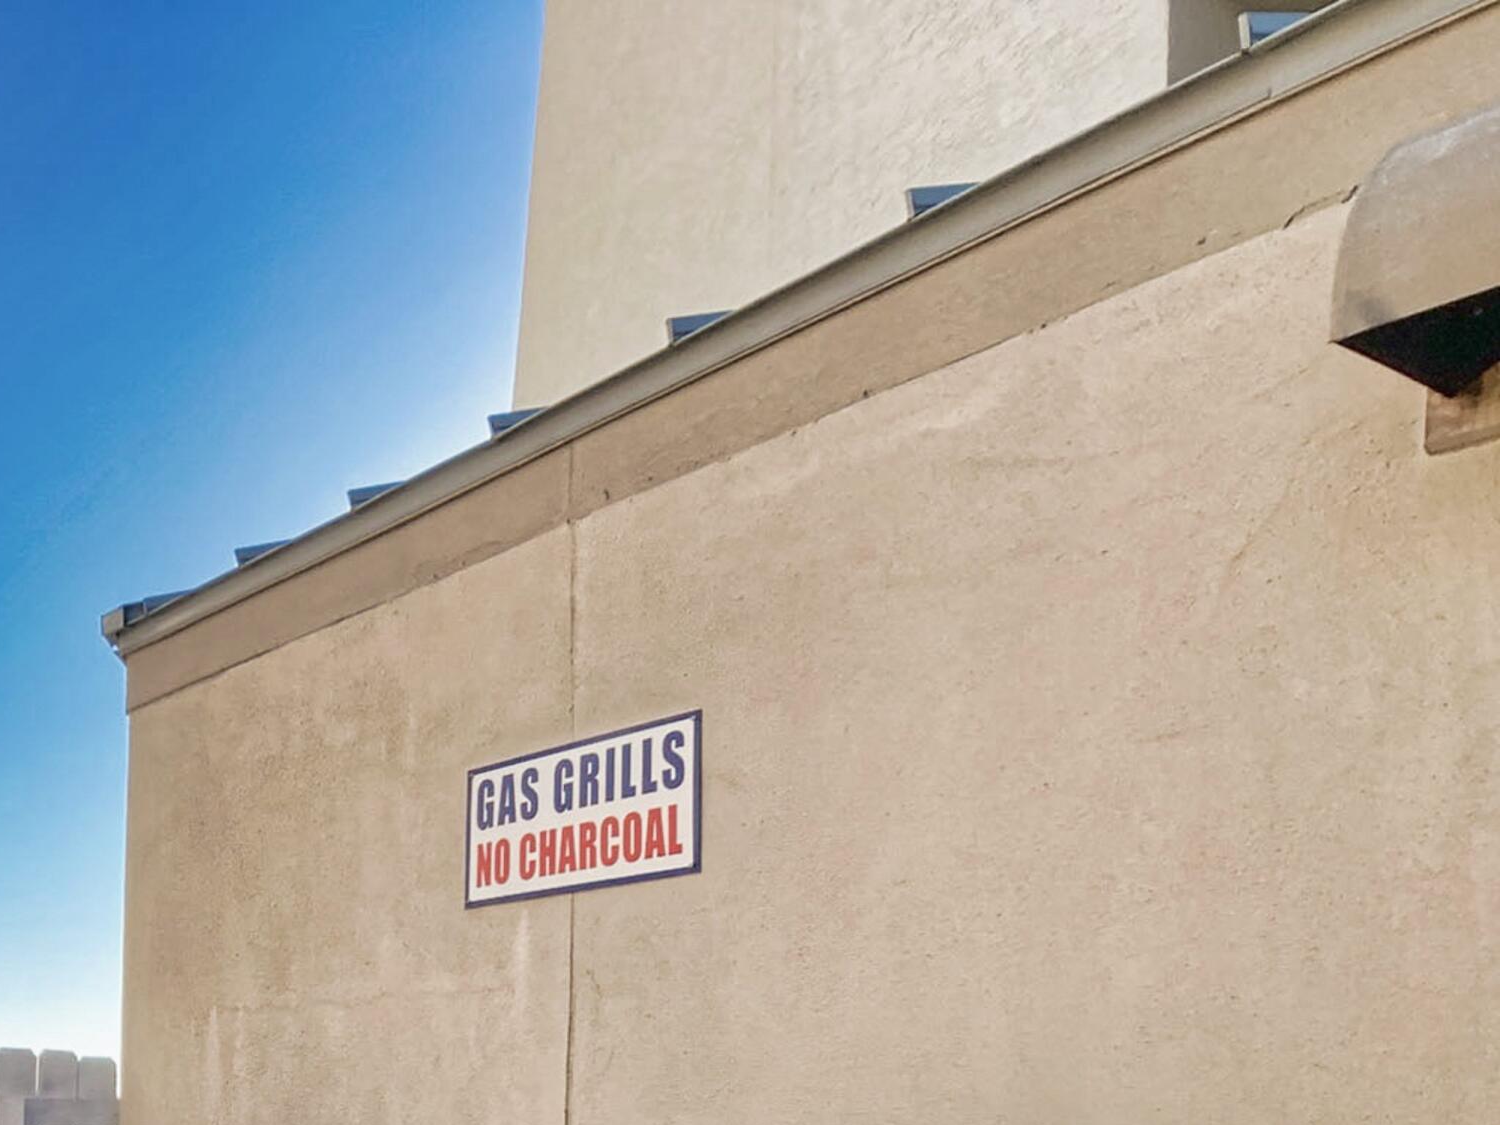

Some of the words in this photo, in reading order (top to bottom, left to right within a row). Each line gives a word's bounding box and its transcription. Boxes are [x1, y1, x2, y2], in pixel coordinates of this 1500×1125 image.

[476, 767, 539, 831] GAS
[553, 730, 685, 814] GRILLS
[476, 837, 511, 888] NO
[519, 804, 683, 881] CHARCOAL
